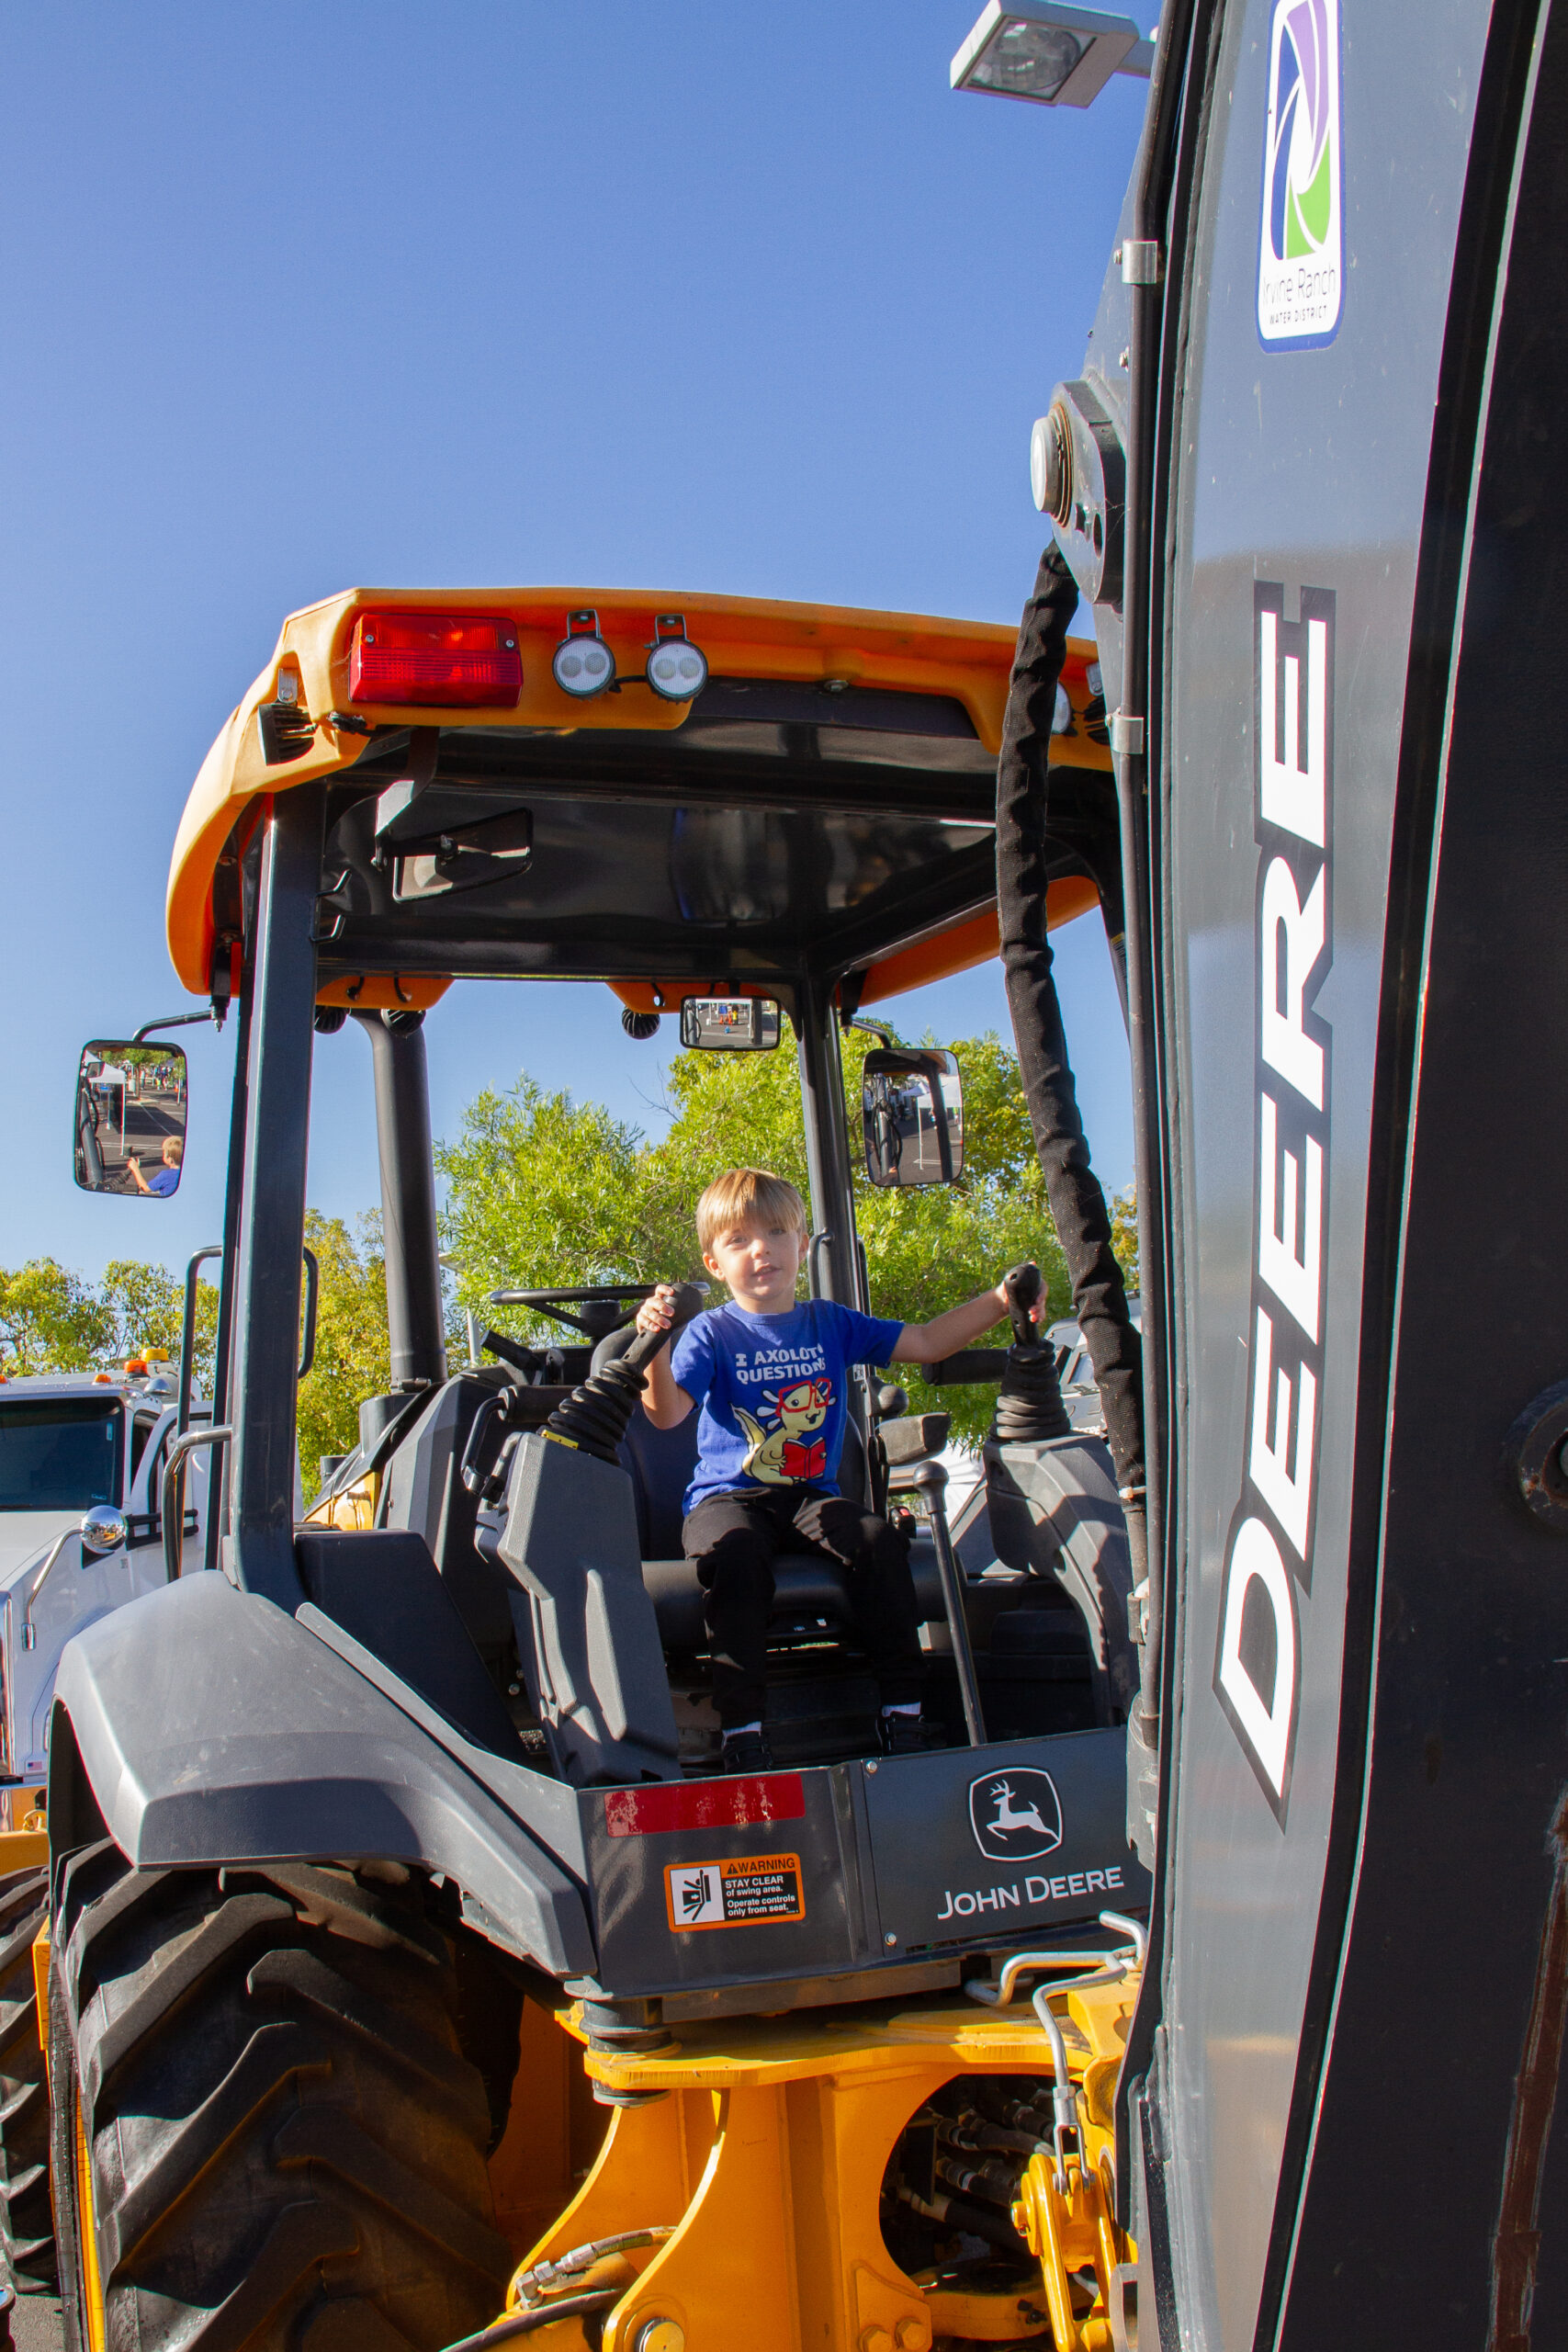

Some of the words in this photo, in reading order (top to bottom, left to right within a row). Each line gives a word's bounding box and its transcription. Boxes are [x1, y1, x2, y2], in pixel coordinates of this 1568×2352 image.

[1298, 264, 1336, 300] Ranch
[1220, 610, 1326, 1799] DEERE
[736, 1353, 748, 1367] I
[738, 1858, 795, 1873] WARNING
[725, 1877, 750, 1889] STAY
[751, 1875, 784, 1886] CLEAR
[726, 1888, 735, 1896] of
[737, 1886, 761, 1896] swing
[762, 1884, 784, 1894] area.
[937, 1883, 1021, 1920] JOHN
[1024, 1865, 1125, 1904] DEERE
[727, 1897, 760, 1909] Operate
[761, 1894, 795, 1905] controls
[728, 1906, 746, 1917] only
[748, 1905, 767, 1915] from
[769, 1903, 789, 1912] seat.
